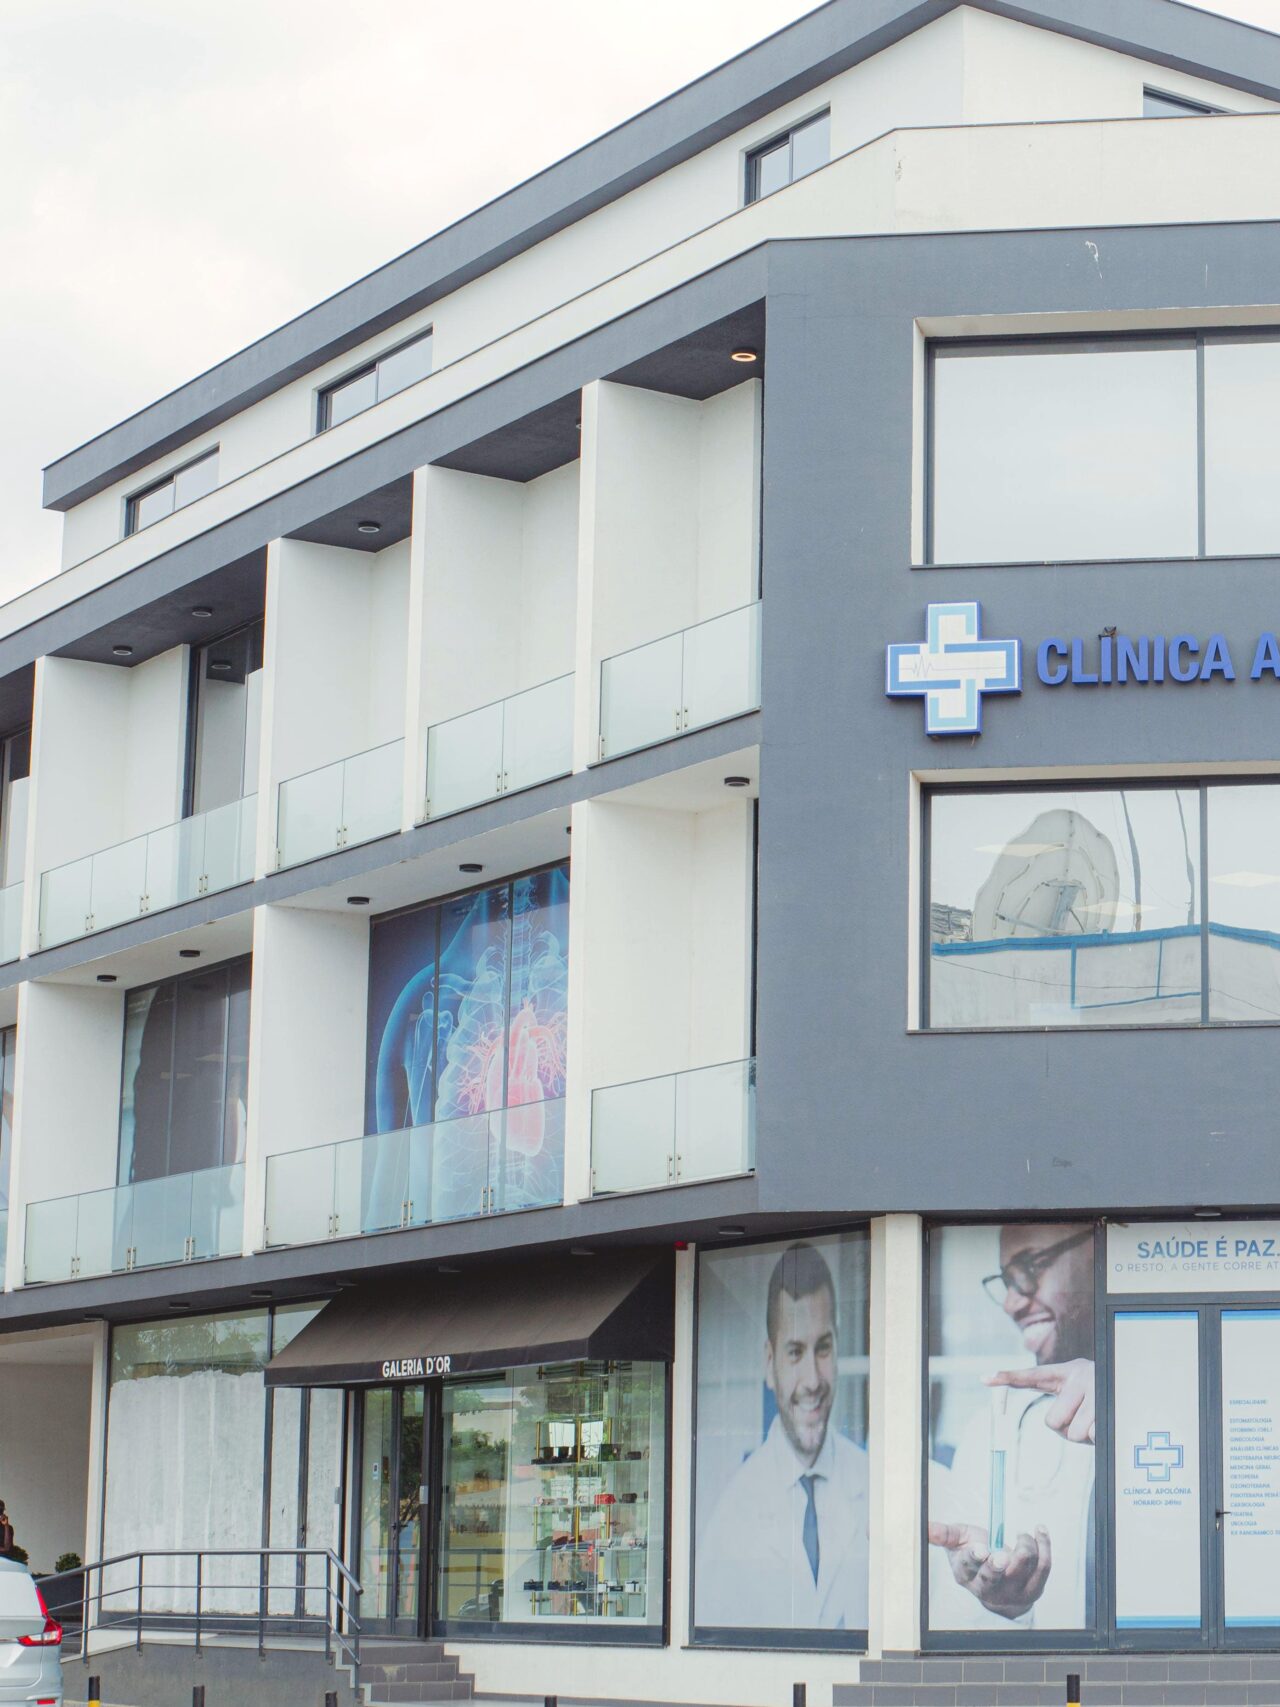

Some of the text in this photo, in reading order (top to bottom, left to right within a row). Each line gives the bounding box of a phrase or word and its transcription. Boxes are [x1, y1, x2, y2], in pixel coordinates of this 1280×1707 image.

[1137, 1236, 1280, 1259] SAÚDE É PAZ.
[1114, 1263, 1123, 1273] O
[1170, 1262, 1178, 1272] A
[1182, 1261, 1220, 1272] GENTE
[1223, 1260, 1262, 1271] CORRE
[382, 1359, 424, 1378] GALERIA
[1123, 1485, 1193, 1495] CLÍNICA APOLÓNIA
